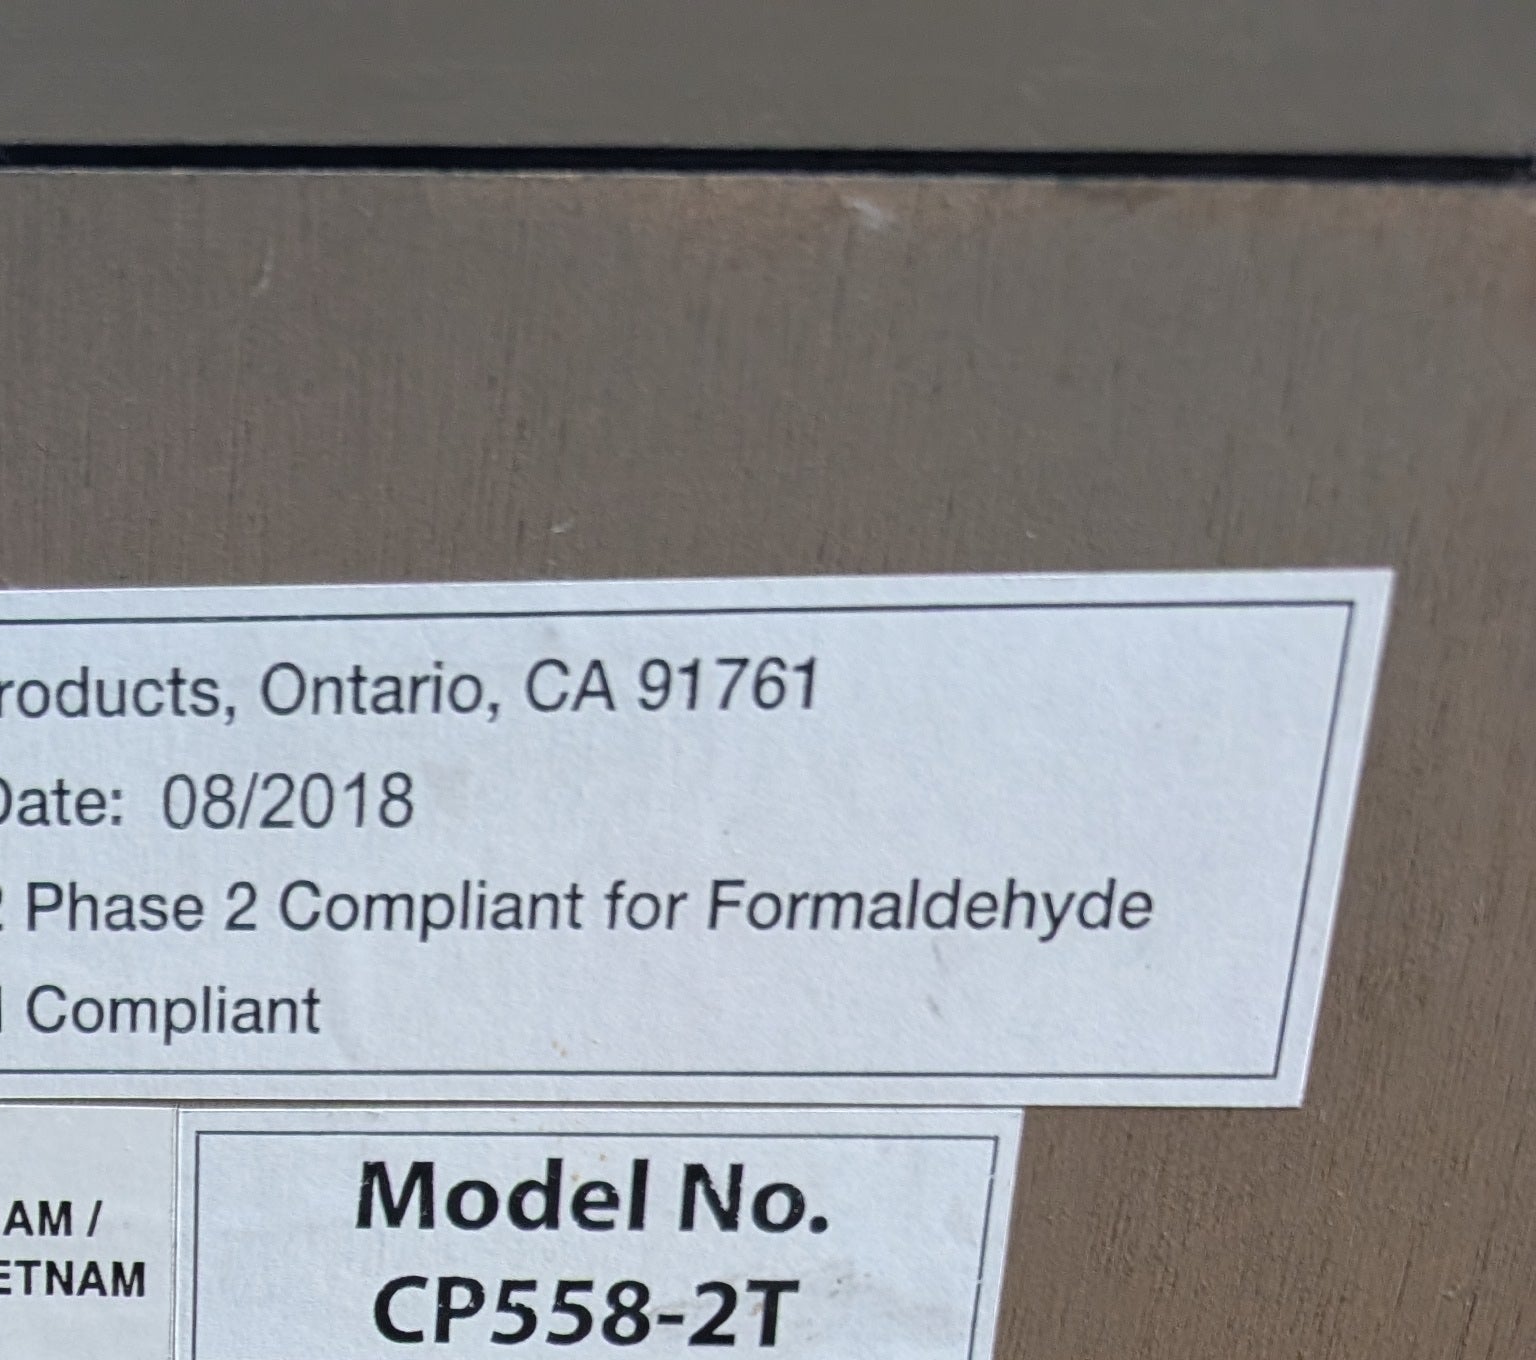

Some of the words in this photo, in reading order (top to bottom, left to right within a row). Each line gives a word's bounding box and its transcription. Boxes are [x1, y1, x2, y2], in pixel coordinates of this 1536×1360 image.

[260, 660, 500, 723] Ontario,
[525, 657, 616, 713] CA
[638, 656, 817, 712] 91761
[162, 771, 414, 830] 08/2018
[27, 880, 205, 932] Phase
[225, 880, 258, 931] 2
[279, 879, 585, 943] Compliant
[604, 879, 689, 931] for
[707, 877, 1154, 944] Formaldehyde
[26, 983, 321, 1046] Compliant
[86, 1199, 103, 1238] /
[355, 1157, 650, 1232] Model
[679, 1162, 829, 1234] No.
[373, 1274, 801, 1348] CP558-2T
